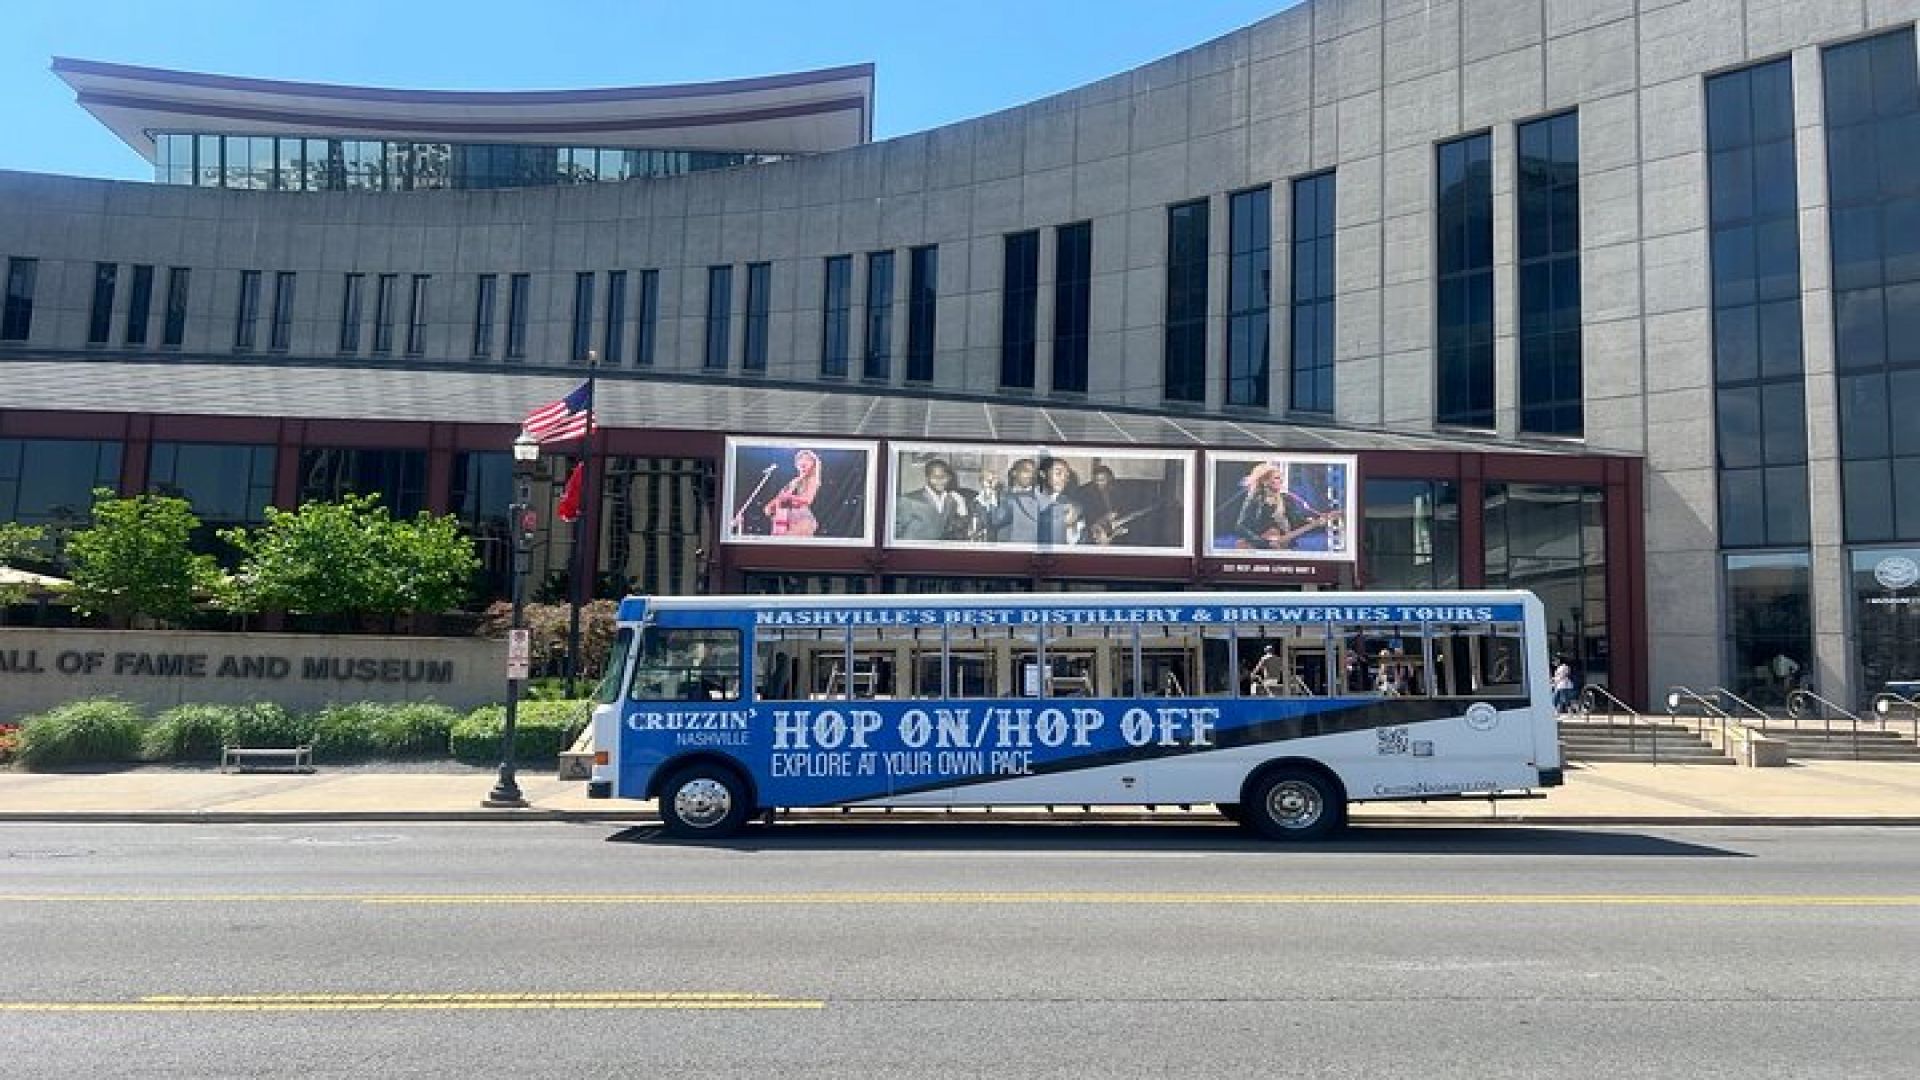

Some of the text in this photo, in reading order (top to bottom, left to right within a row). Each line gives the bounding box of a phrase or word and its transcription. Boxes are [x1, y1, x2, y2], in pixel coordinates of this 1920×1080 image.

[756, 605, 1493, 624] NASHVILLE'S BEST DISTILLERY & BREWERIES TOURS
[56, 652, 105, 675] OF
[114, 652, 208, 677] FAME
[215, 655, 291, 679] AND
[303, 657, 454, 683] MUSEUM
[627, 708, 758, 730] CRUZZIN'
[773, 710, 884, 749] HOP
[1120, 707, 1220, 746] OFF
[677, 731, 751, 746] NASHVILLE
[772, 750, 1035, 777] EXPLORE AT YOUR OWN PACE
